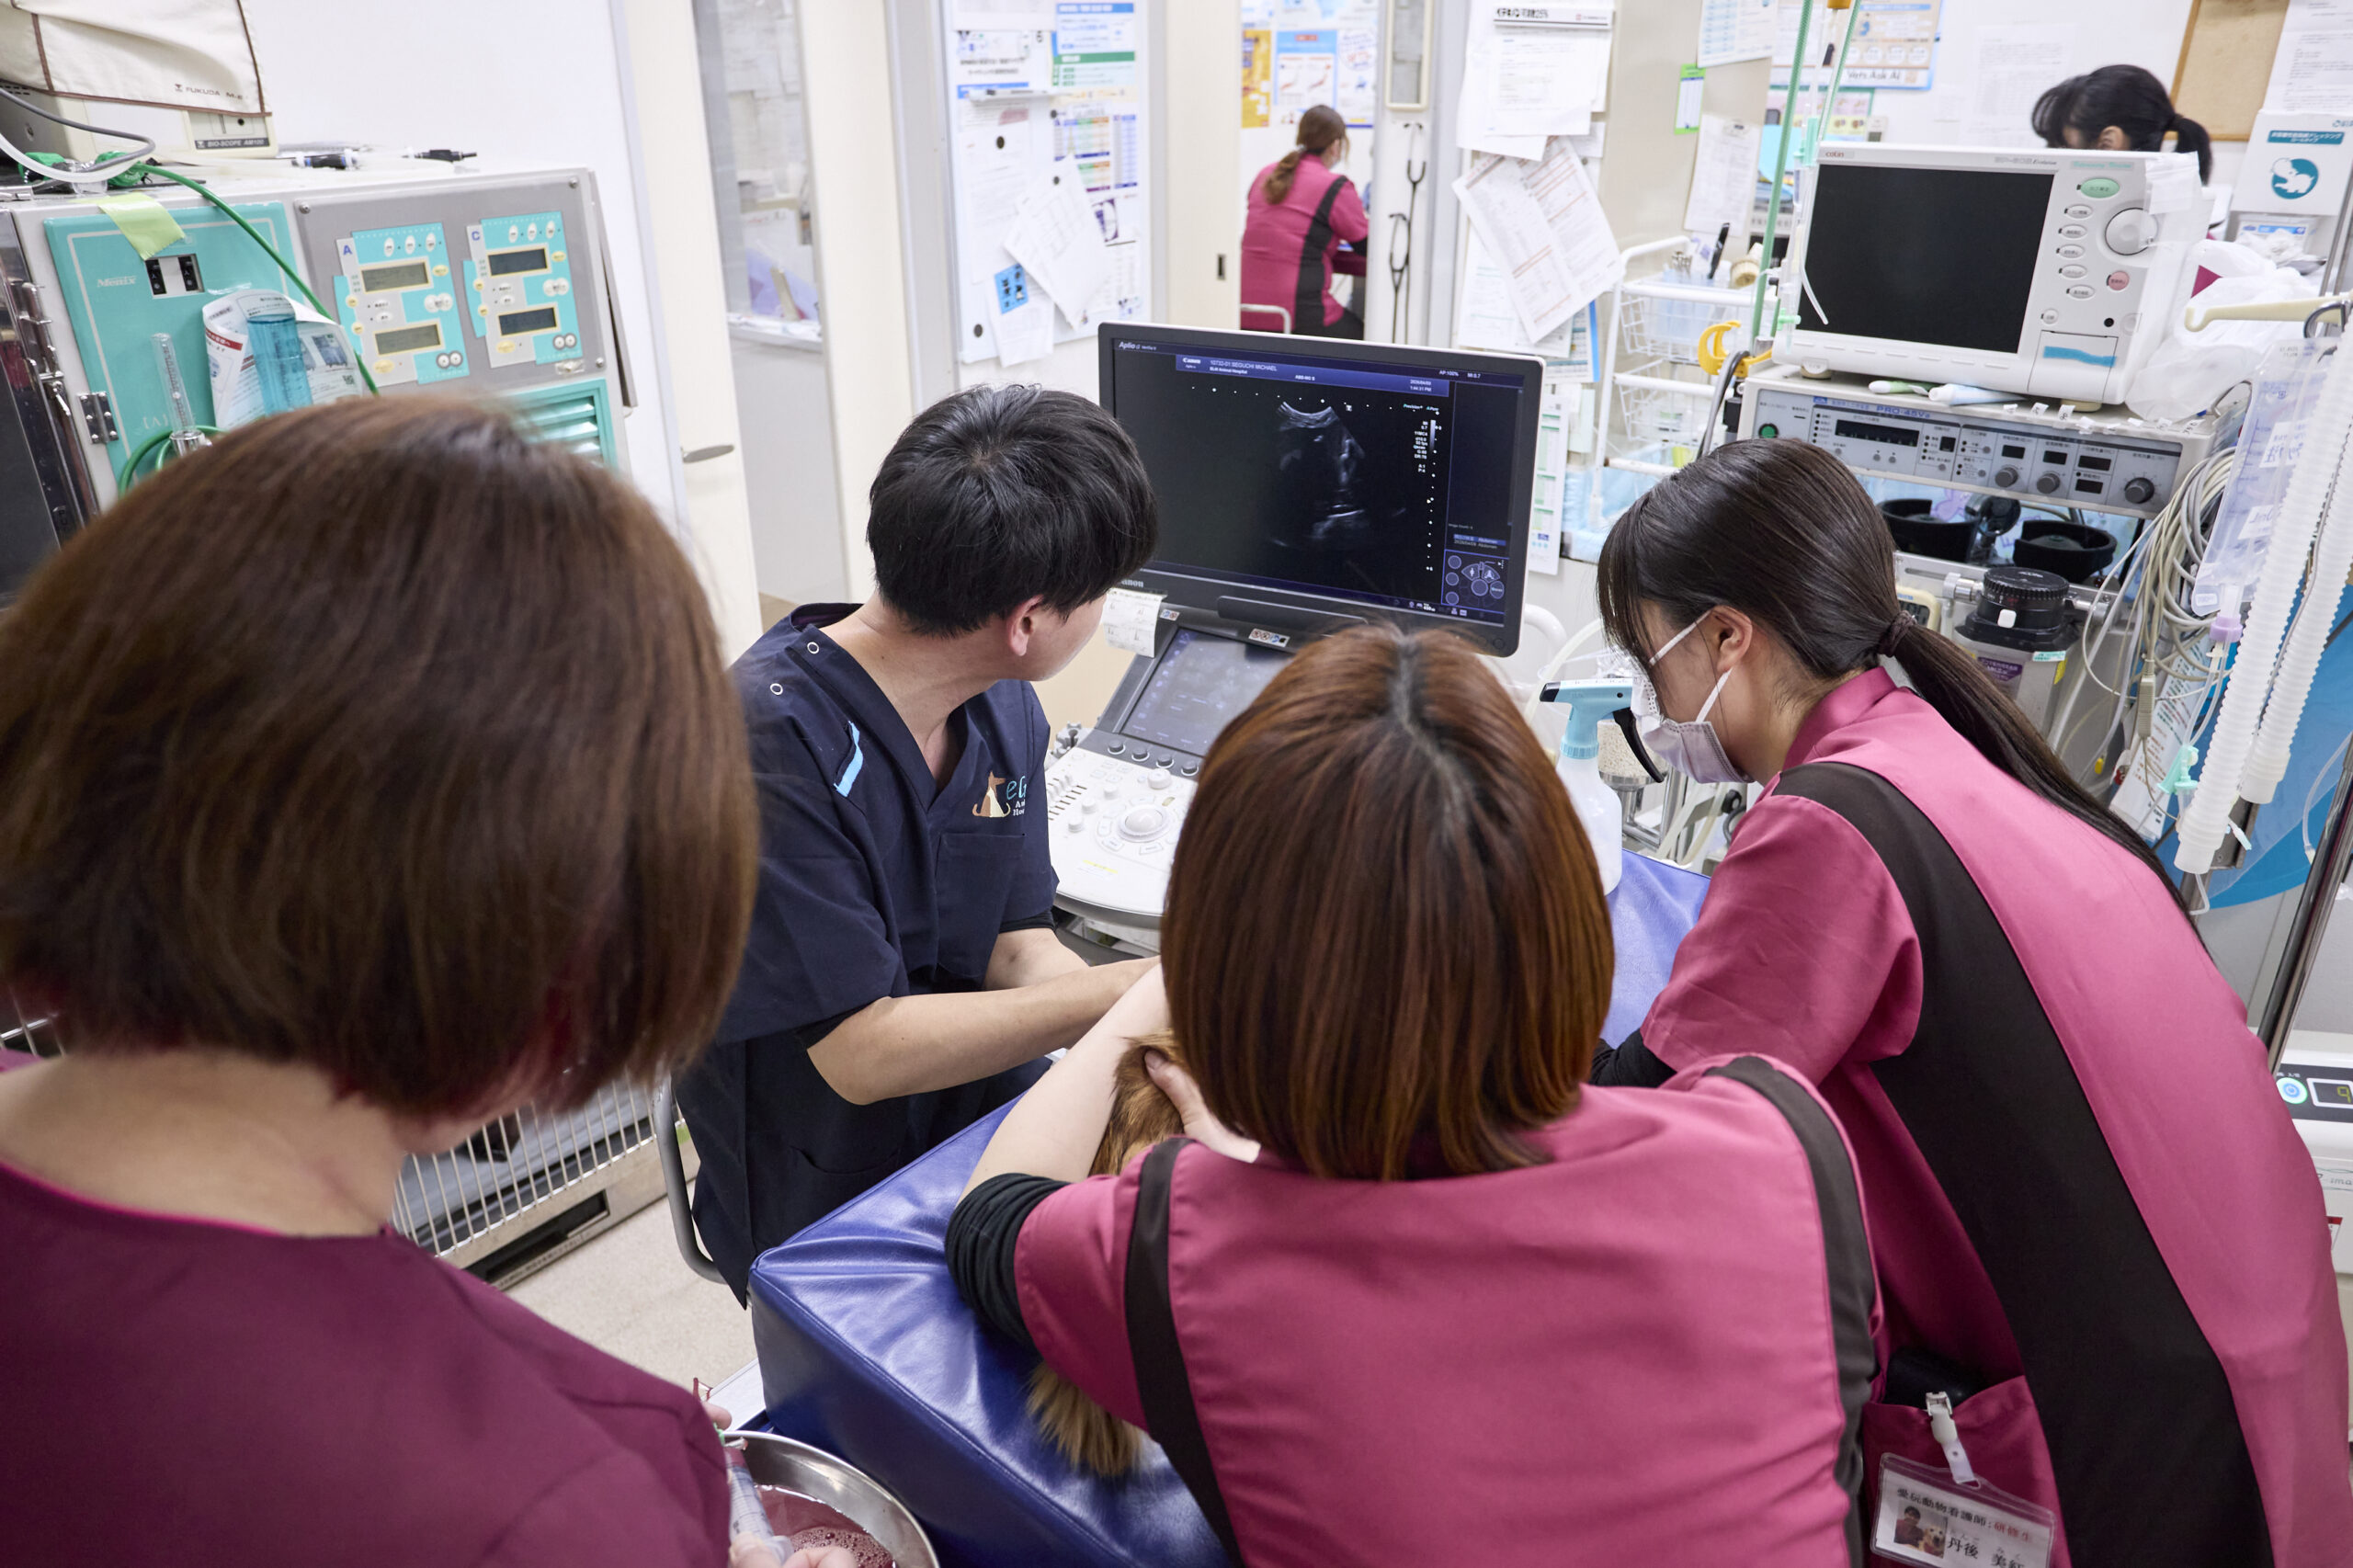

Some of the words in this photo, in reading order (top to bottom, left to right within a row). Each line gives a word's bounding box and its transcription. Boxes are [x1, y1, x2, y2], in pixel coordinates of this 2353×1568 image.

[186, 86, 220, 97] FUKUDA
[472, 231, 481, 241] C
[343, 244, 353, 256] A
[97, 276, 136, 288] Menix
[1119, 341, 1135, 350] Aplio
[1121, 579, 1143, 588] anon
[1948, 1537, 1979, 1559] 丹後
